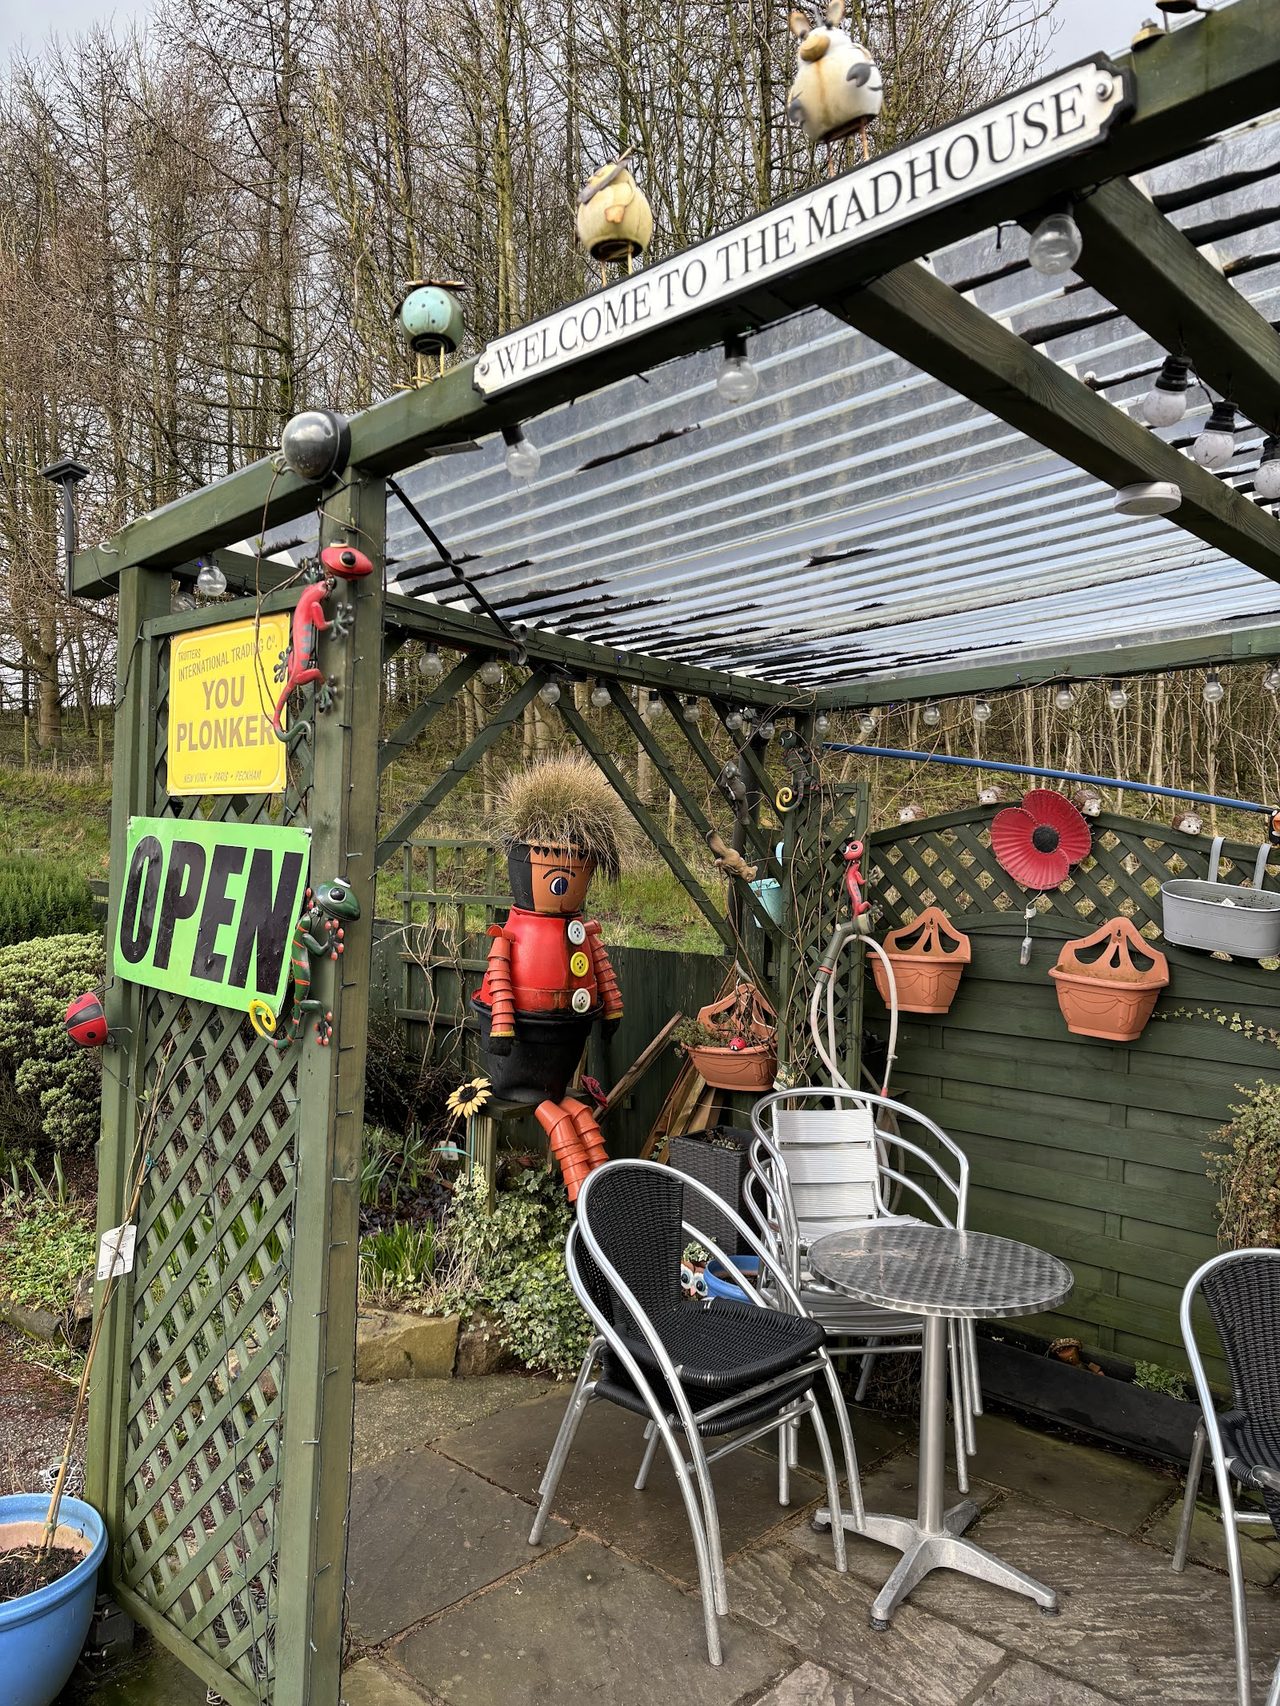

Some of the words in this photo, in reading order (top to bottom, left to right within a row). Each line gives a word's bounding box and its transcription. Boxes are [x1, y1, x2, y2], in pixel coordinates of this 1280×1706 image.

[494, 282, 652, 378] WELCOME
[659, 258, 707, 309] TO
[716, 215, 797, 284] THE
[805, 83, 1086, 247] MADHOUSE
[178, 648, 201, 662] TROTTERS
[178, 651, 230, 682] INTERNATIONAL
[202, 675, 245, 711] YOU
[176, 714, 275, 752] PLONKER
[213, 771, 230, 782] PARIS
[235, 769, 262, 782] PECKHAM
[120, 835, 304, 996] OPEN
